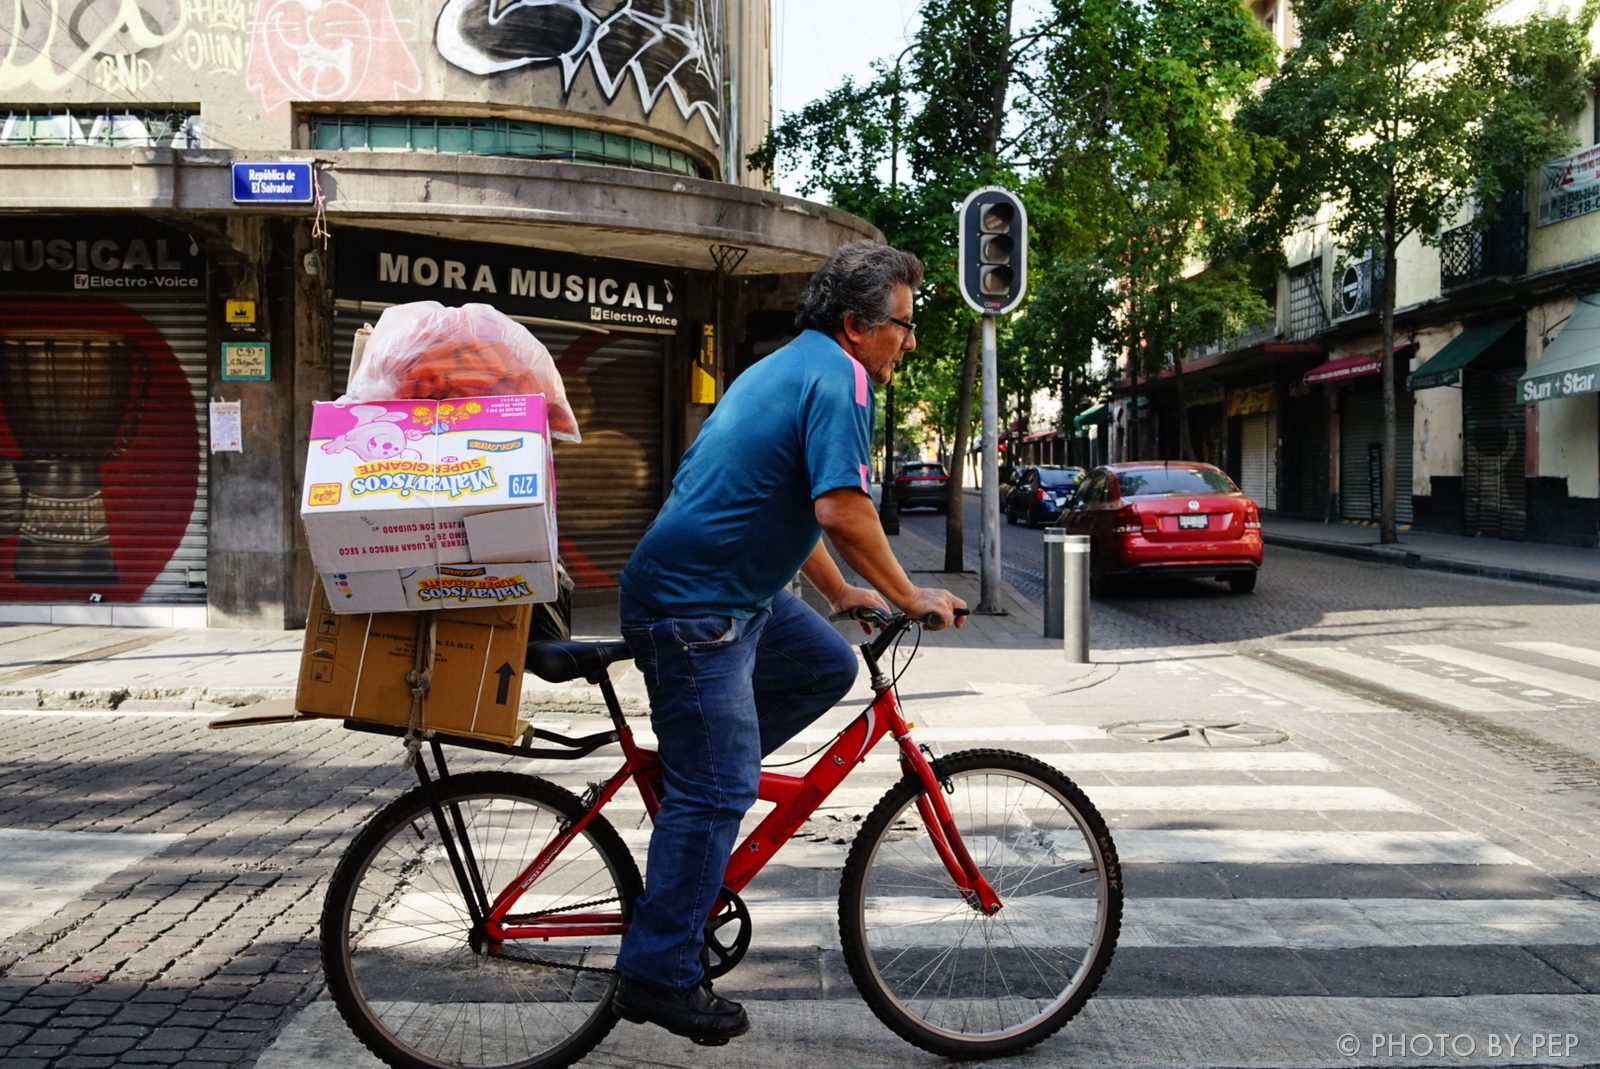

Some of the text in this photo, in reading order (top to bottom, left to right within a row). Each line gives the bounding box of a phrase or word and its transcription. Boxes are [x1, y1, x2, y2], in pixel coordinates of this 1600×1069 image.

[248, 169, 296, 183] República de
[251, 182, 294, 194] El Salvador
[90, 275, 199, 287] Electro-Voice
[379, 252, 664, 311] MORA MUSICAL
[602, 309, 678, 327] Electro-Voice
[1523, 373, 1595, 401] Sun Star
[360, 458, 481, 476] SUPER GIGANTE
[351, 466, 496, 497] Malvaviscos
[513, 476, 533, 494] 279
[383, 525, 417, 534] CUIDADO
[421, 522, 435, 531] CON
[339, 547, 359, 556] SECO
[370, 546, 399, 554] FRESCO
[402, 544, 426, 552] LUGAR
[420, 580, 477, 589] GIGANTE
[479, 578, 518, 588] SUPER
[419, 582, 533, 602] Malvaviscos
